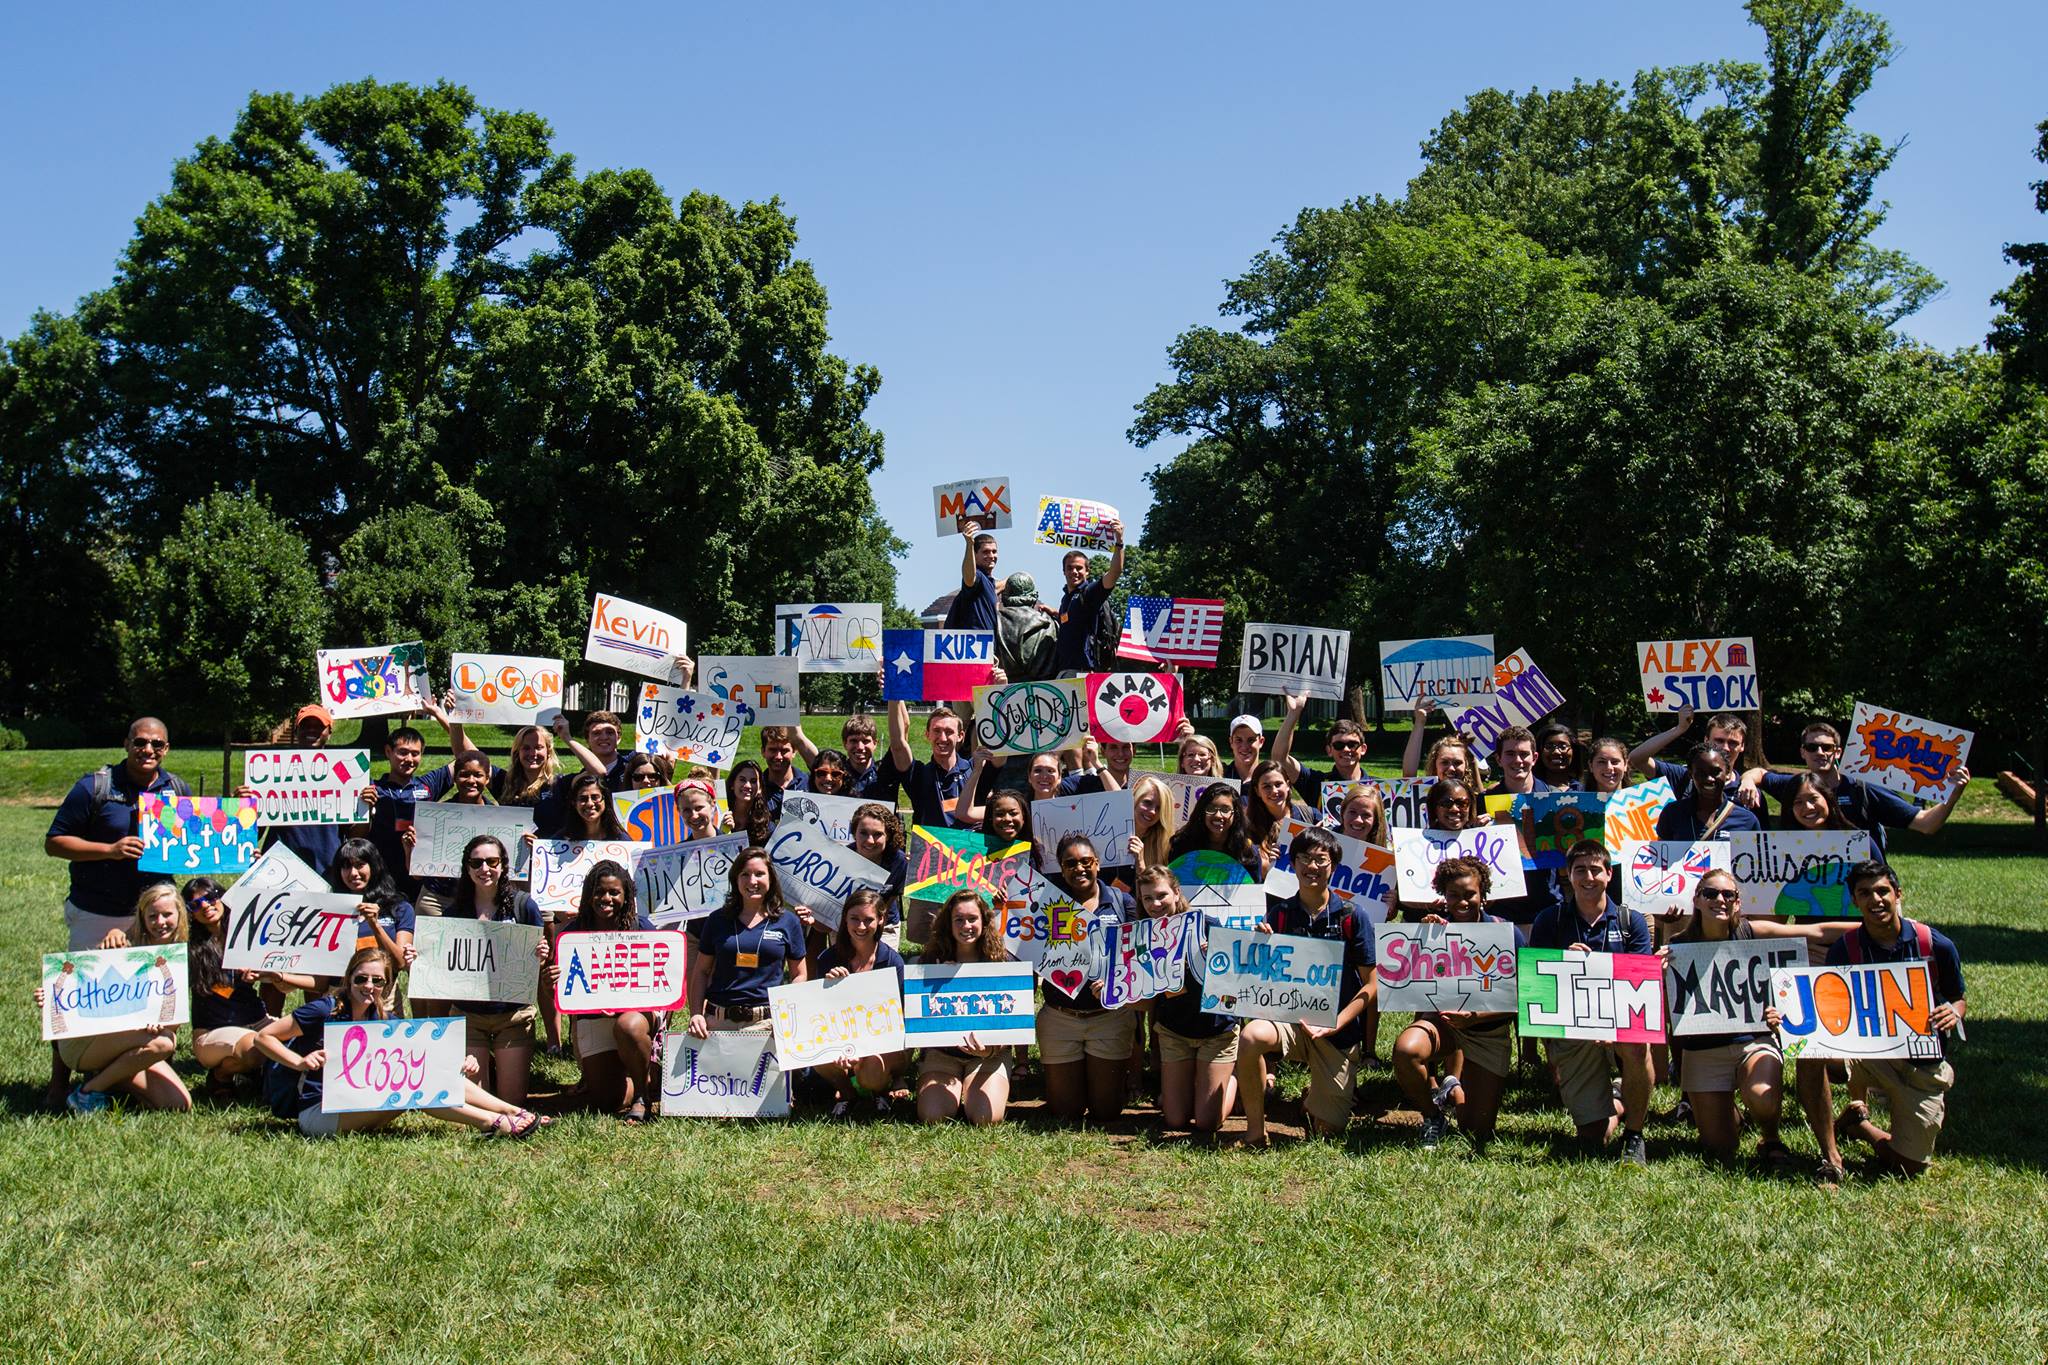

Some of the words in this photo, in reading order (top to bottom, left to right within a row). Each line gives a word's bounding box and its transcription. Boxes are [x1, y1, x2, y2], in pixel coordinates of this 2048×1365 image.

[939, 485, 1011, 519] MAX
[1038, 503, 1115, 540] ALEX
[1046, 532, 1109, 551] SNEIDER
[594, 598, 669, 649] Kevin
[777, 614, 880, 661] TAYLOR
[935, 634, 993, 660] KURT
[1249, 633, 1341, 679] BRIAN
[1643, 640, 1722, 673] ALEX
[461, 666, 558, 704] LOGAN
[1098, 675, 1168, 712] MARK
[1384, 663, 1493, 702] VIRGINIA
[1664, 674, 1757, 711] STOCK
[639, 700, 719, 746] Jessica
[978, 689, 1089, 750] SANDRA
[250, 753, 328, 784] CIAO
[1869, 729, 1953, 781] Bobby
[1731, 833, 1845, 885] allison
[448, 938, 495, 972] JULIA
[563, 943, 672, 995] AMBER
[1070, 952, 1090, 968] the
[52, 977, 176, 1014] Katherine
[1528, 960, 1661, 1032] JIM
[1781, 967, 1932, 1036] JOHN
[663, 1048, 750, 1097] Jessica
